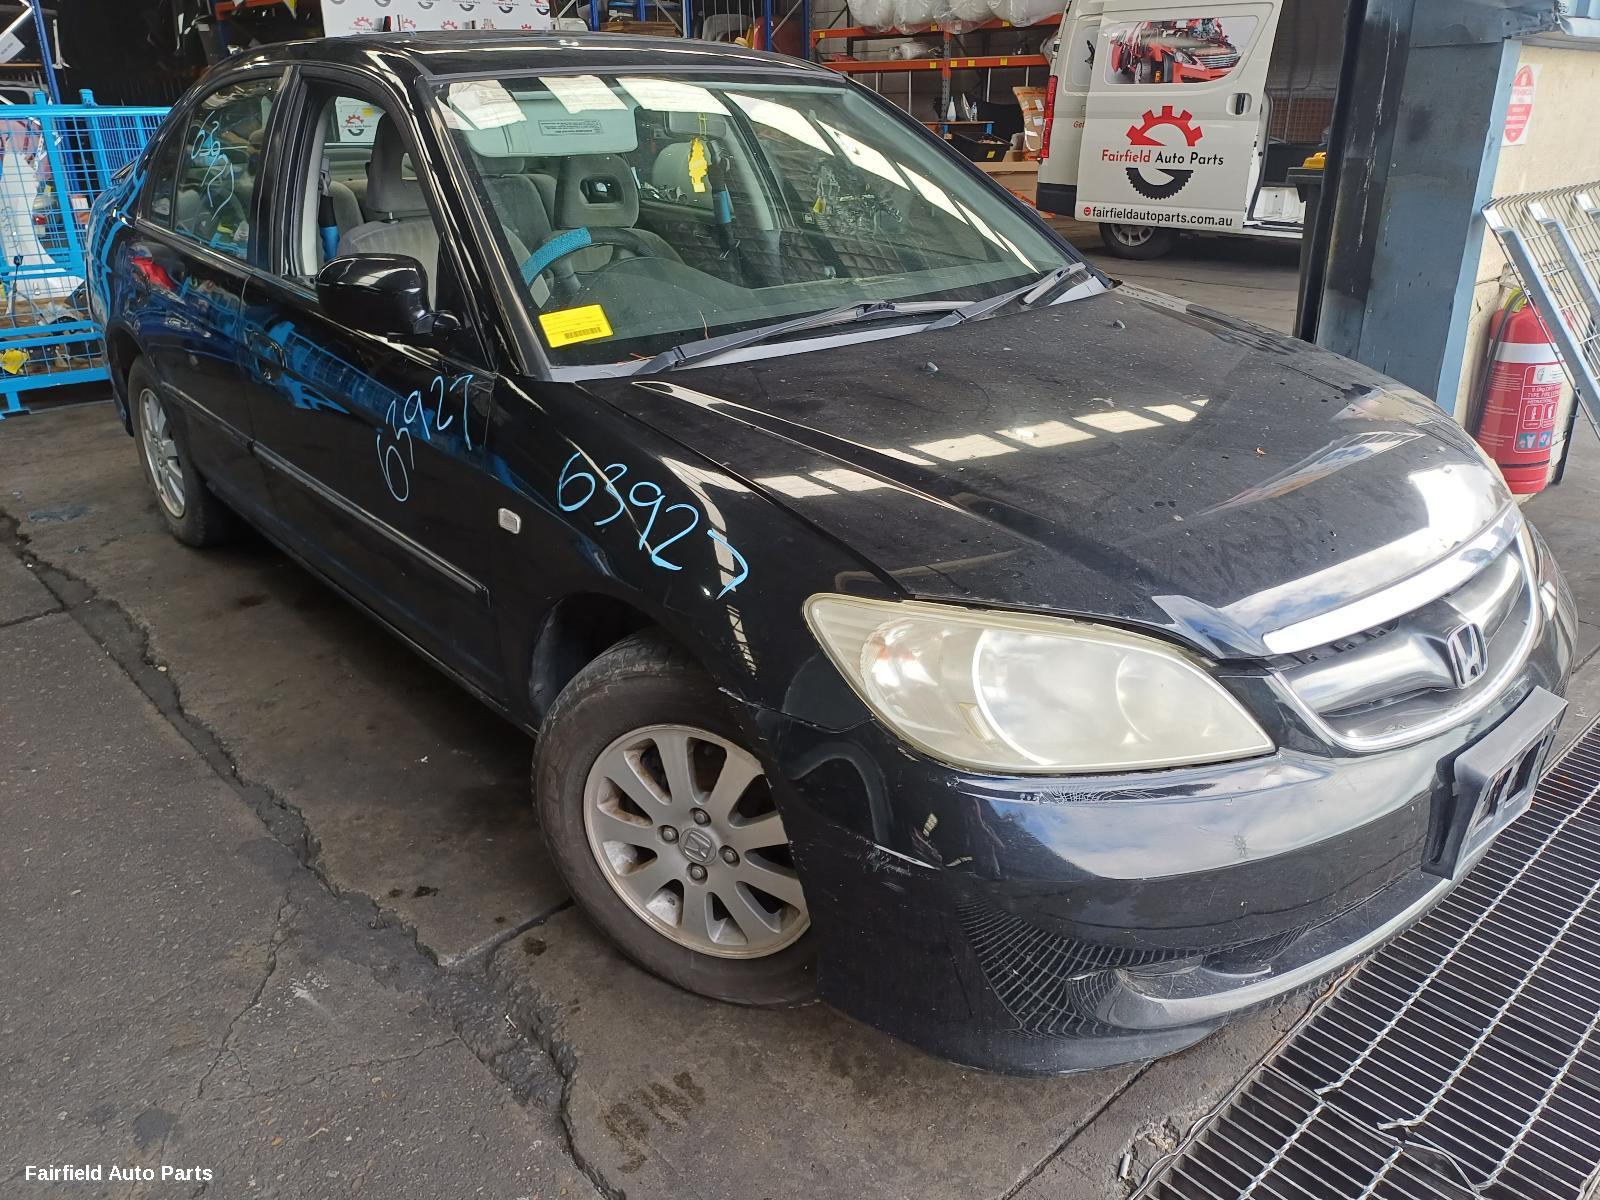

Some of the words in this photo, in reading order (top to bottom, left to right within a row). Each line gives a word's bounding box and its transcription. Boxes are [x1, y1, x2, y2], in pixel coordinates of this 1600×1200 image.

[1101, 149, 1151, 164] Fairfield
[1155, 152, 1185, 165] Auto
[1190, 151, 1224, 166] Parts
[1092, 206, 1233, 227] fairfieldautoparts.com.au
[376, 373, 474, 502] 63927
[557, 451, 750, 600] 63927
